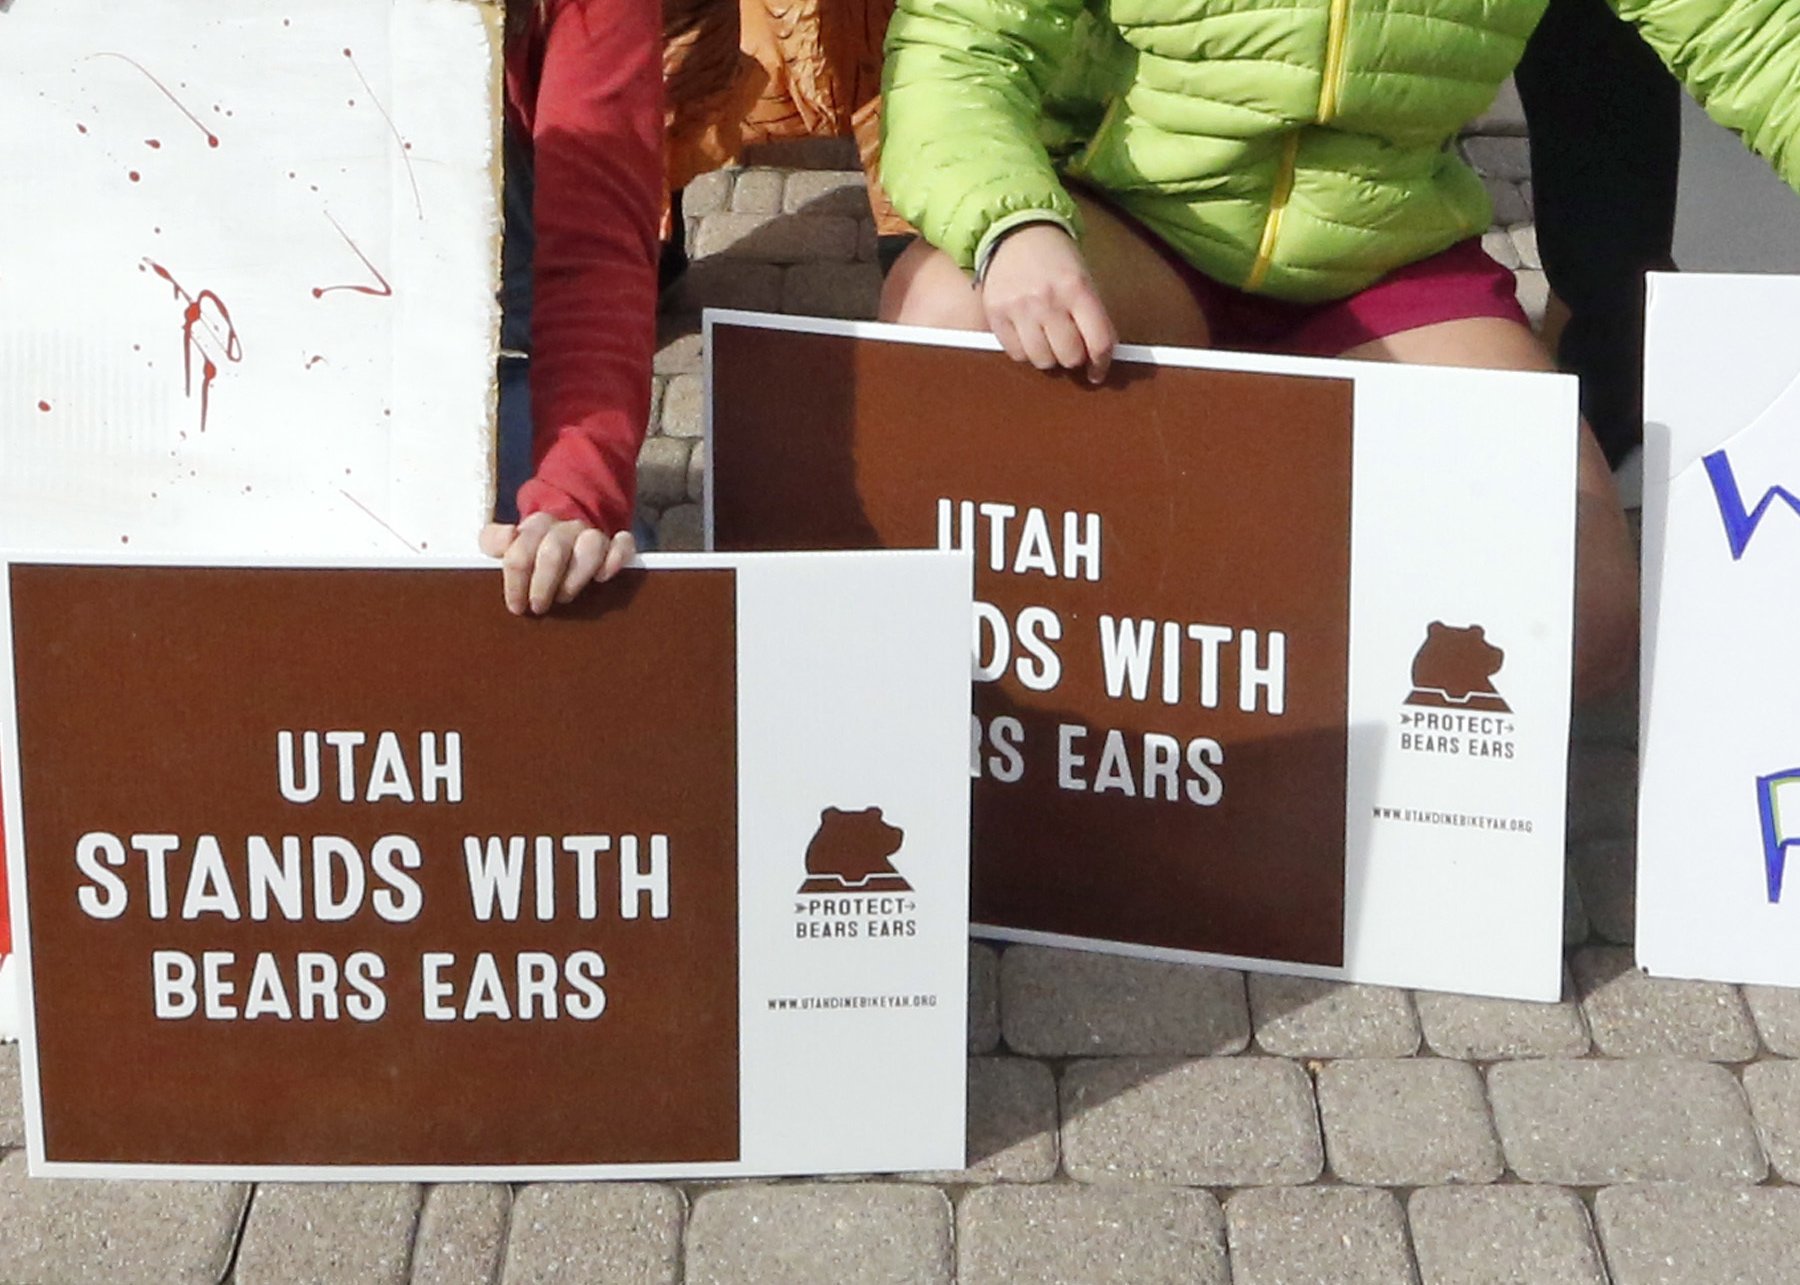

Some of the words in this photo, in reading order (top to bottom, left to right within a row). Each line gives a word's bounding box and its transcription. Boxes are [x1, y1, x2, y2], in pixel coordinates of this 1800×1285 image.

[1098, 613, 1286, 716] WITH
[1401, 733, 1460, 754] BEARS
[1468, 738, 1515, 759] EARS
[1413, 711, 1506, 735] PROTECT
[277, 730, 463, 804] UTAH
[1057, 722, 1225, 807] EARS
[75, 831, 423, 923] STANDS
[463, 833, 670, 921] WITH
[795, 920, 859, 939] BEARS
[867, 919, 917, 938] EARS
[808, 897, 906, 916] PROTECT
[152, 950, 387, 1022] BEARS
[421, 949, 607, 1021] EARS
[767, 994, 938, 1010] WWW.UTAHDINEBIKEYAH.ORG
